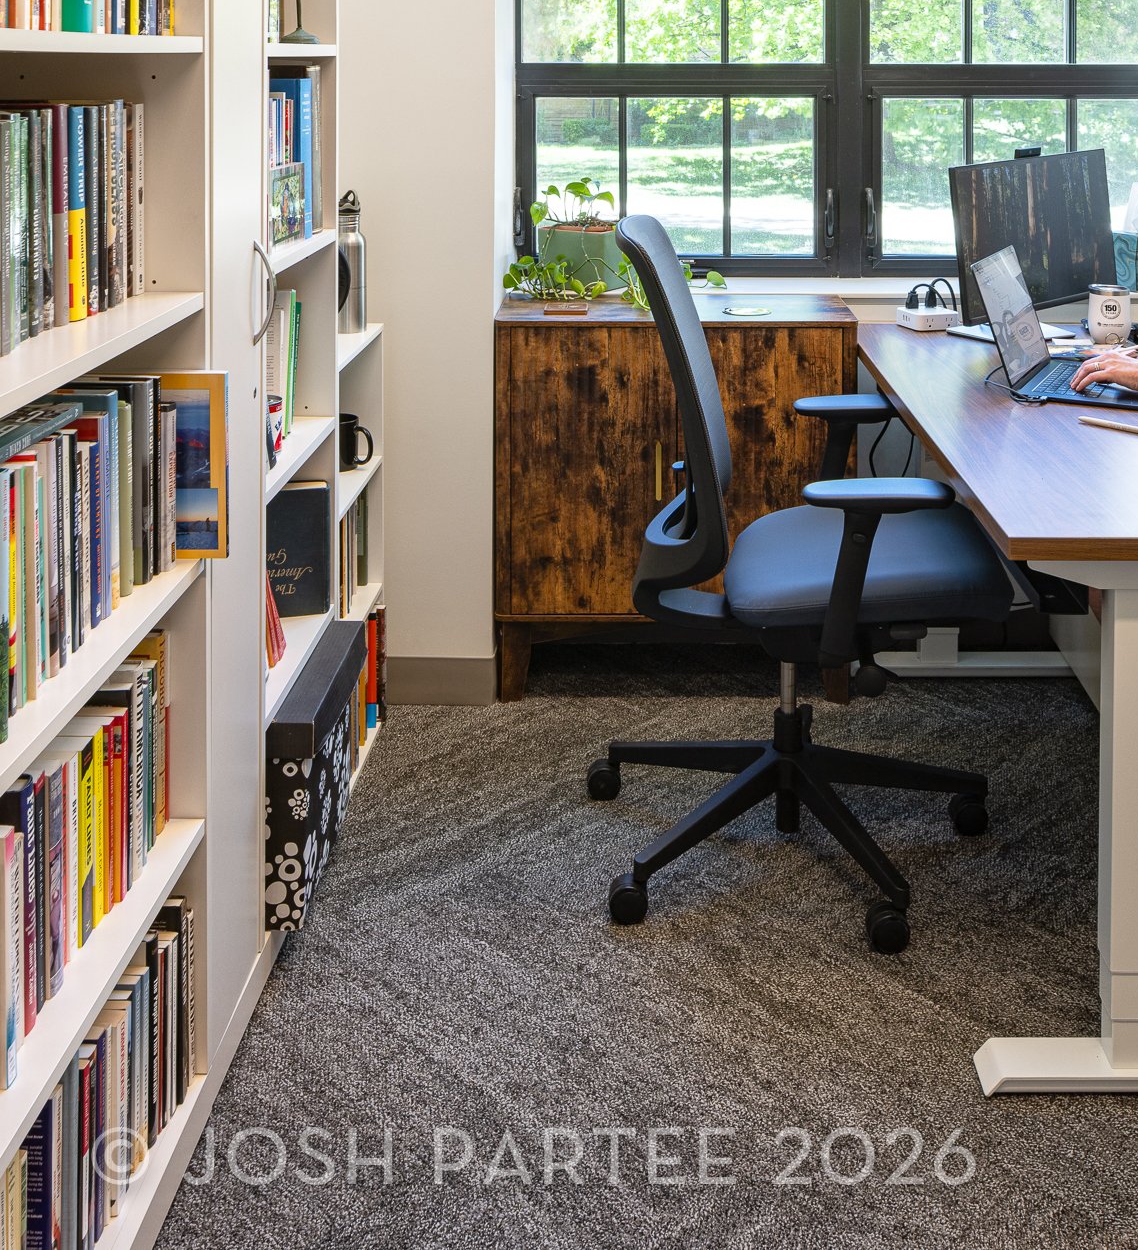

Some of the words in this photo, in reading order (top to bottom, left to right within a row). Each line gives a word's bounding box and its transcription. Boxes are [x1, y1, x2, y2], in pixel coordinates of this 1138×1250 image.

[1104, 304, 1117, 312] 150
[267, 566, 313, 581] Ameri
[275, 583, 297, 595] The
[136, 673, 144, 722] MYTH
[136, 727, 144, 801] AMERICA
[26, 793, 36, 848] Fault
[98, 848, 103, 857] of
[26, 850, 36, 904] Lines
[152, 1025, 158, 1035] of
